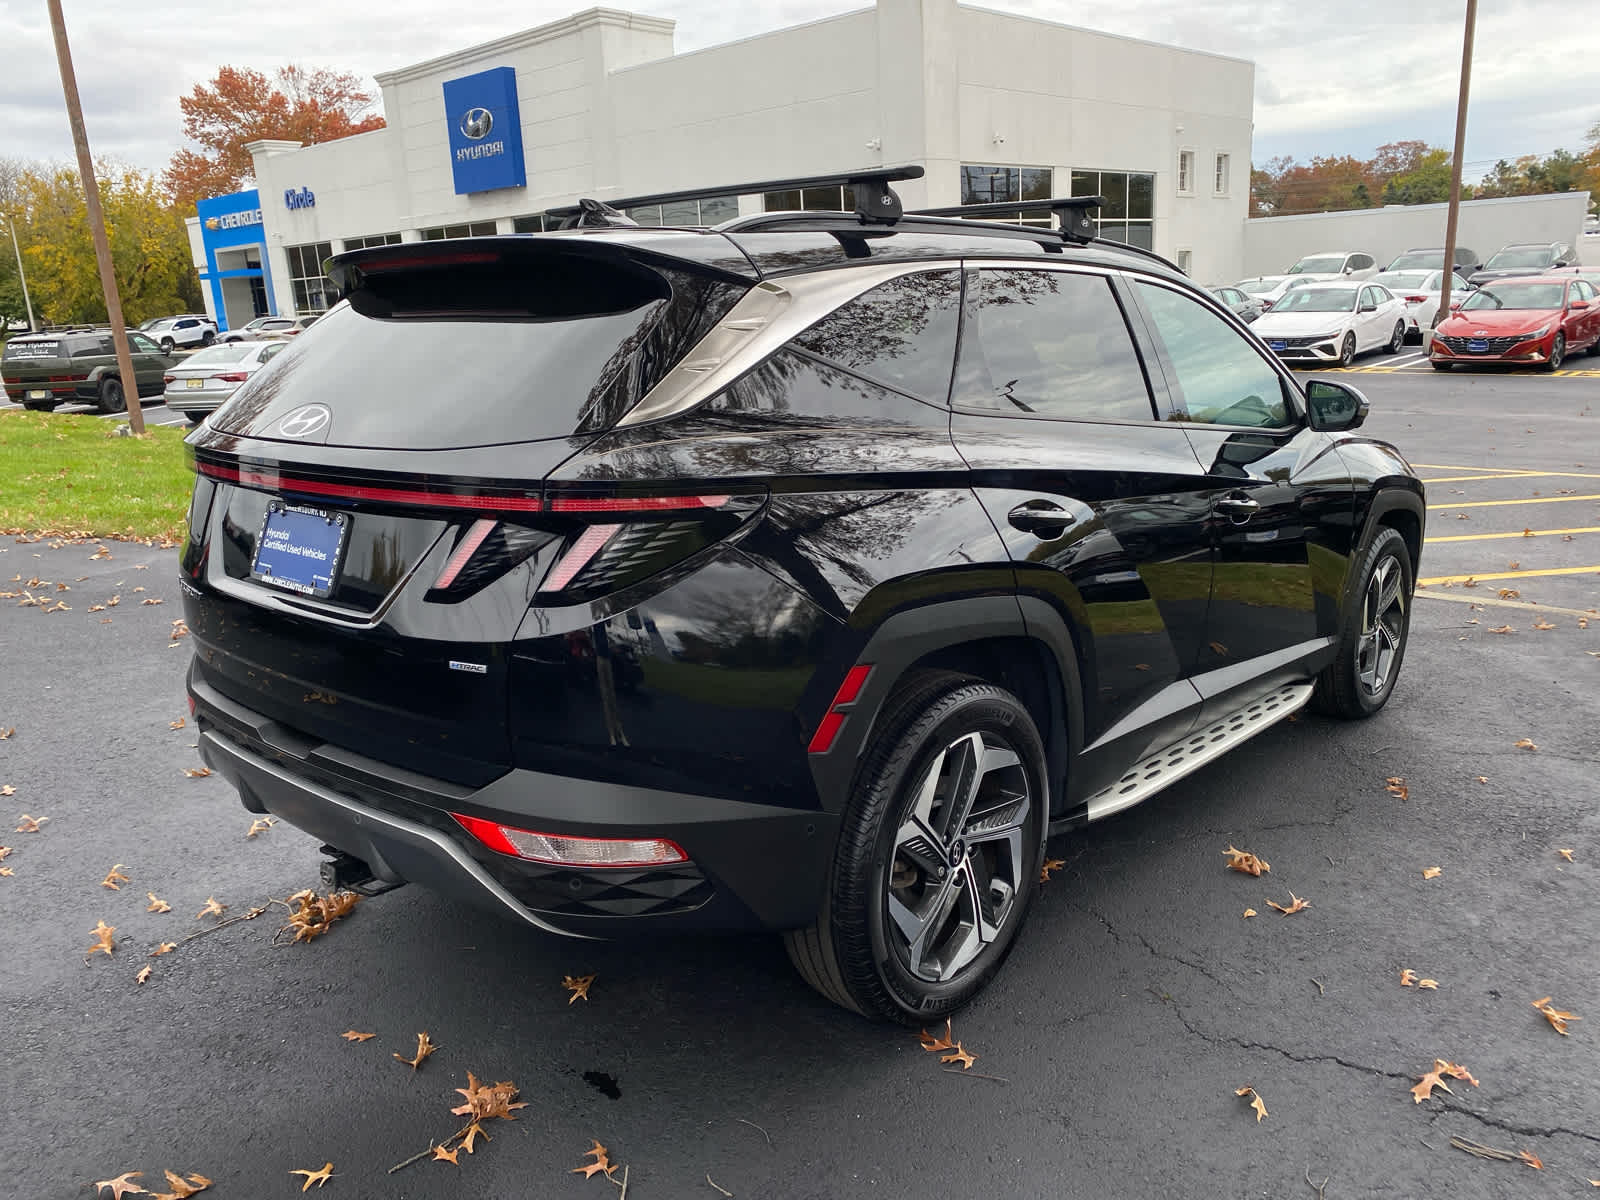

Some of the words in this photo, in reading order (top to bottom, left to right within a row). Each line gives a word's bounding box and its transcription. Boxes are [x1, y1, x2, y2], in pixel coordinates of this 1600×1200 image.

[456, 141, 504, 161] HYUNDAI
[285, 186, 315, 210] Circle
[220, 209, 263, 230] CHEVROLE
[266, 527, 289, 541] Hyundai
[263, 538, 287, 552] Certified
[287, 544, 301, 556] Used
[302, 547, 327, 560] Vehicles
[261, 575, 314, 595] WWW.CIRCLEAUTO.COM
[450, 662, 486, 672] HTRAC
